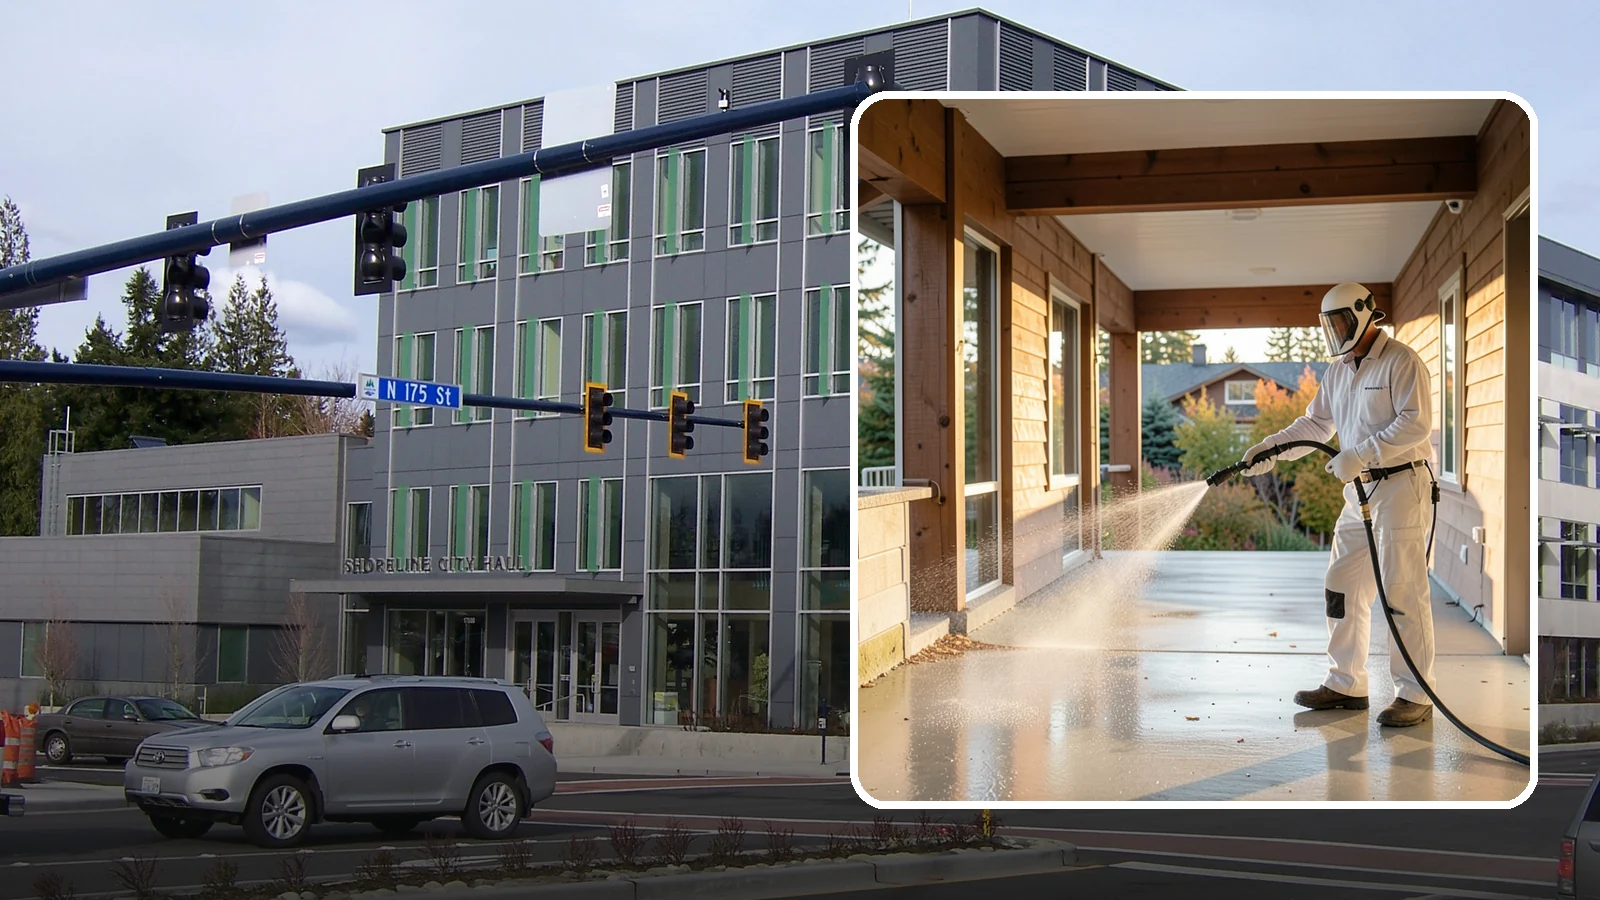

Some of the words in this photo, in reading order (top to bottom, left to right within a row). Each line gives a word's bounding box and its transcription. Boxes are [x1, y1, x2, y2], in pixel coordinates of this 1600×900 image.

[387, 381, 396, 400] N
[405, 382, 428, 403] 175
[436, 386, 451, 406] St
[344, 557, 432, 574] SHORELINE
[438, 556, 476, 572] CITY
[484, 556, 526, 572] HALL
